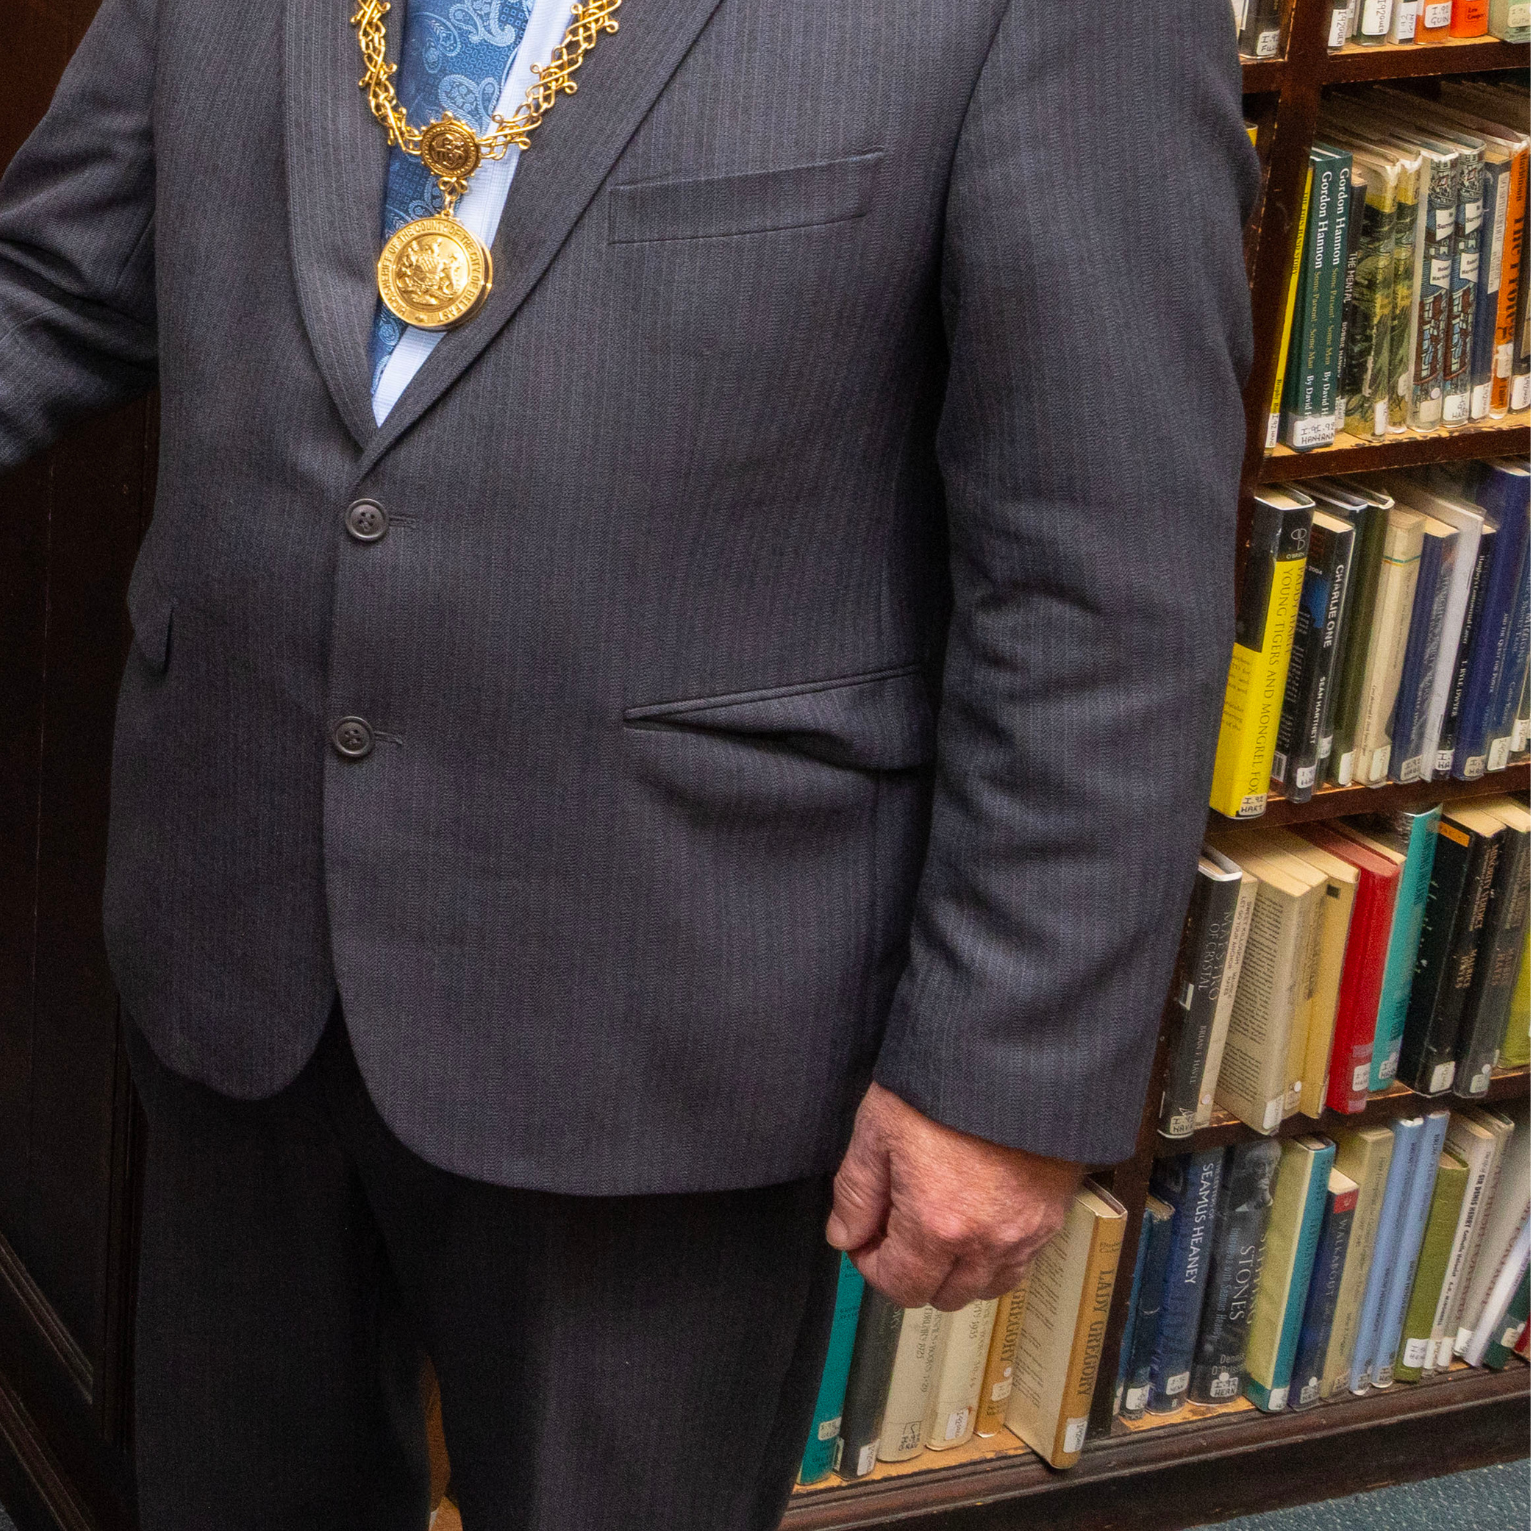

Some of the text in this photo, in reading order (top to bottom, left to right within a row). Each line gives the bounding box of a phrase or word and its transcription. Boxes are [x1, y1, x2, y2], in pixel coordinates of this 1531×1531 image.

[1314, 171, 1333, 269] Gordon Hannon
[1323, 564, 1344, 648] CHARLIE ONE
[1183, 1162, 1214, 1285] SEAMUS HEANEY
